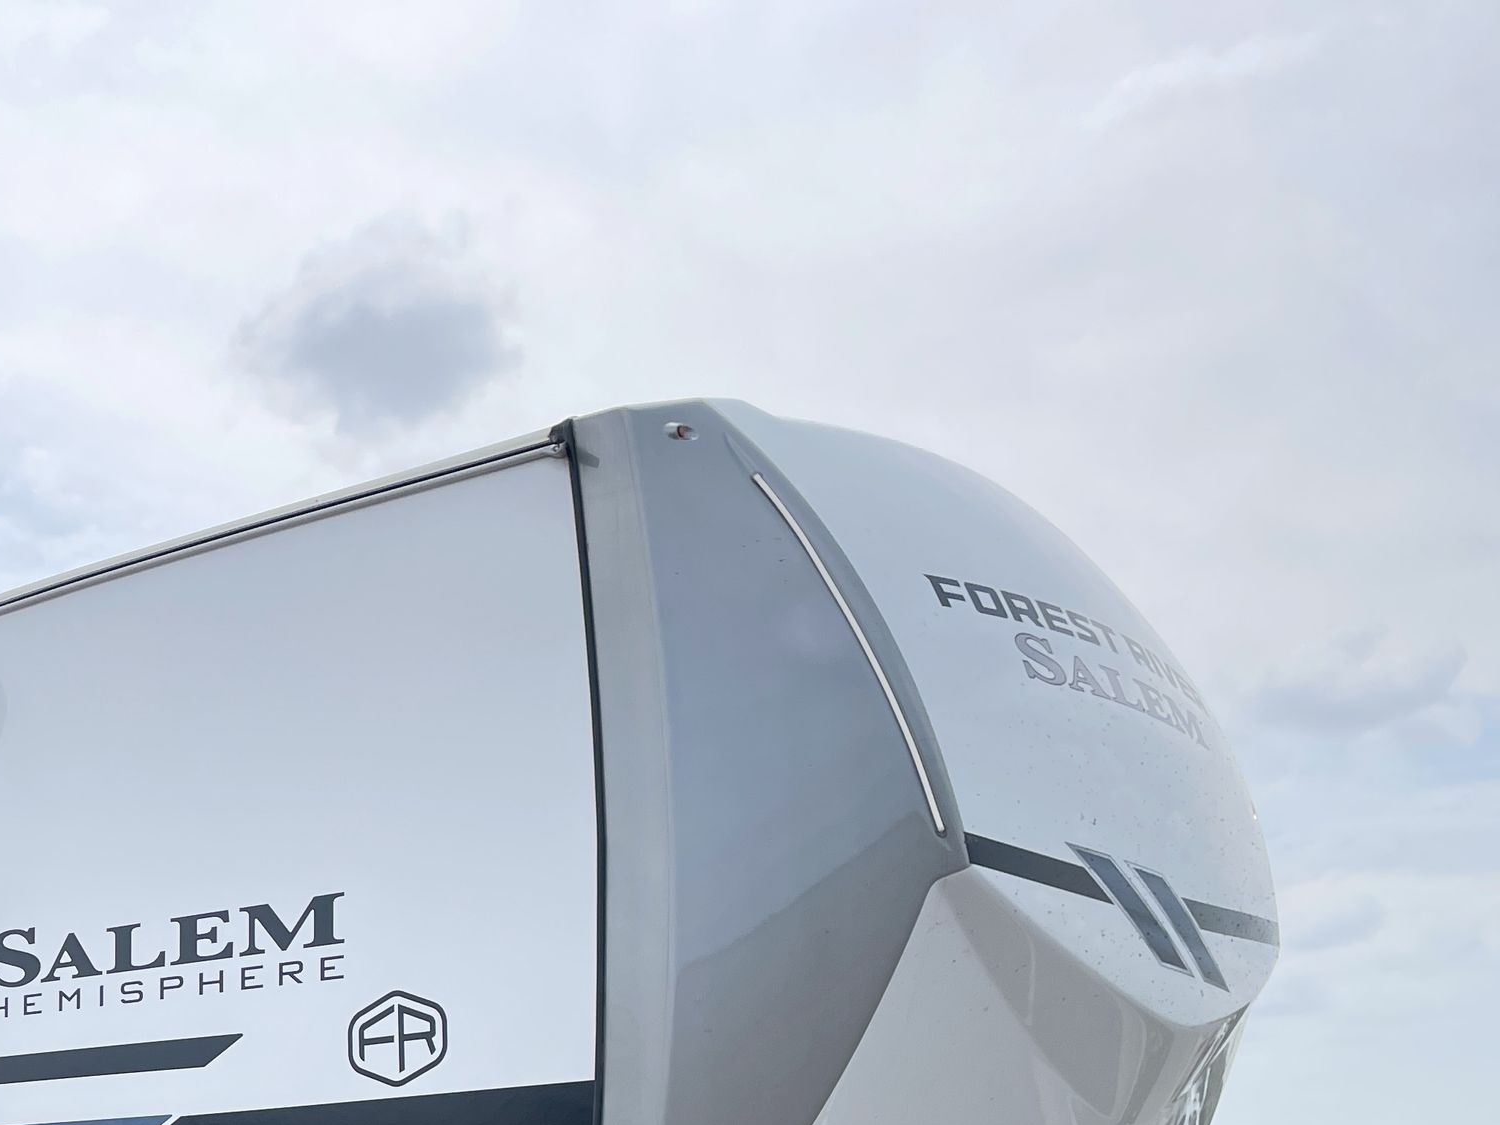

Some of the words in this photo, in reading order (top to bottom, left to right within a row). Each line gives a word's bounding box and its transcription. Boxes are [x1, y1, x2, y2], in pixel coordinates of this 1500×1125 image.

[923, 573, 1118, 654] FOREST
[1120, 633, 1211, 718] RIVER
[1014, 632, 1210, 750] SALEM
